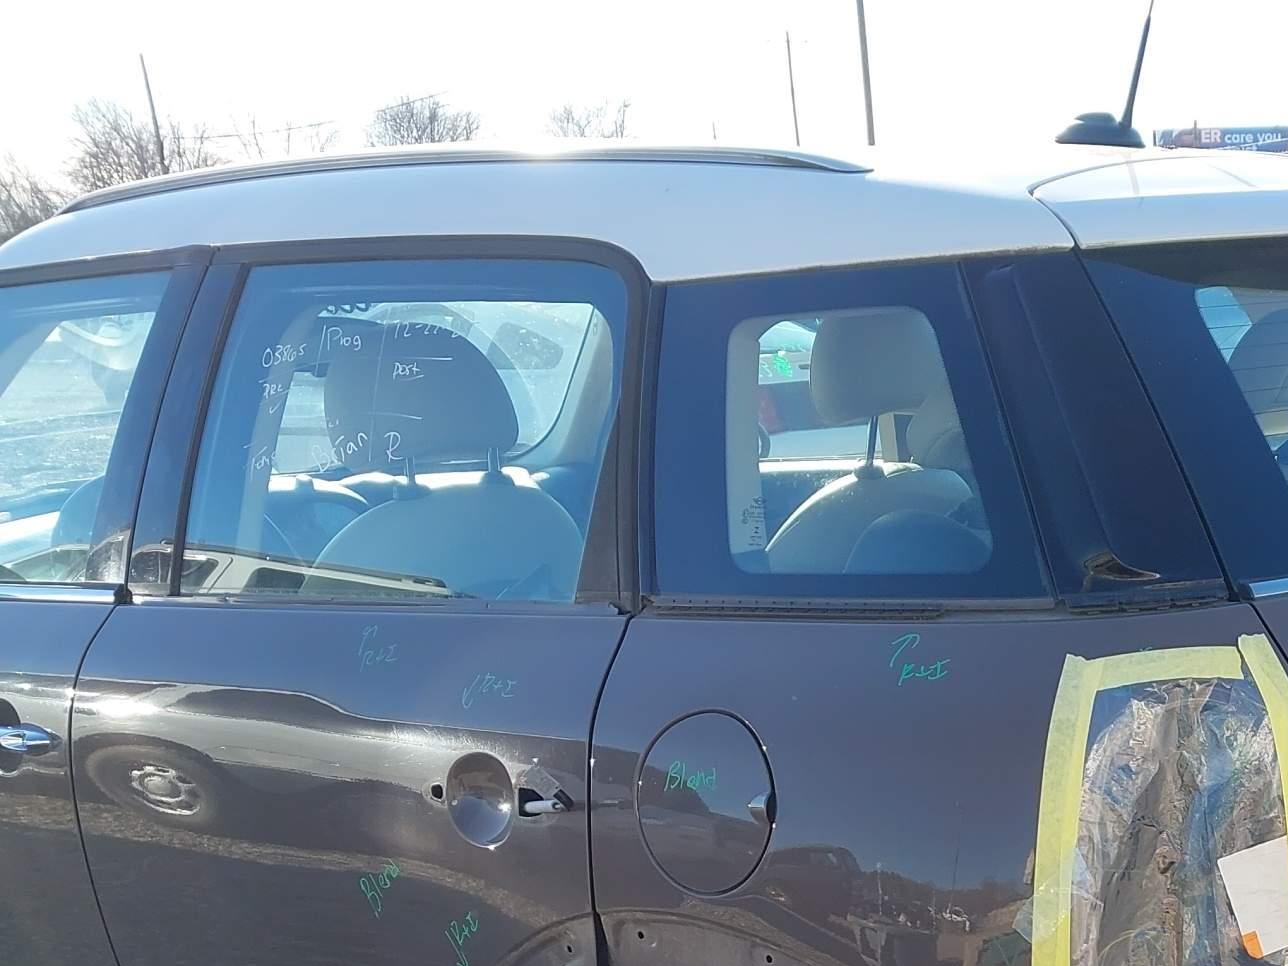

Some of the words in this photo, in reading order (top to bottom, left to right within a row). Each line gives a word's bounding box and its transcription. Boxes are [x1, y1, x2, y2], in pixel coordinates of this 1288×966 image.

[1201, 128, 1221, 143] ER
[1225, 133, 1254, 143] care
[1257, 132, 1281, 145] you
